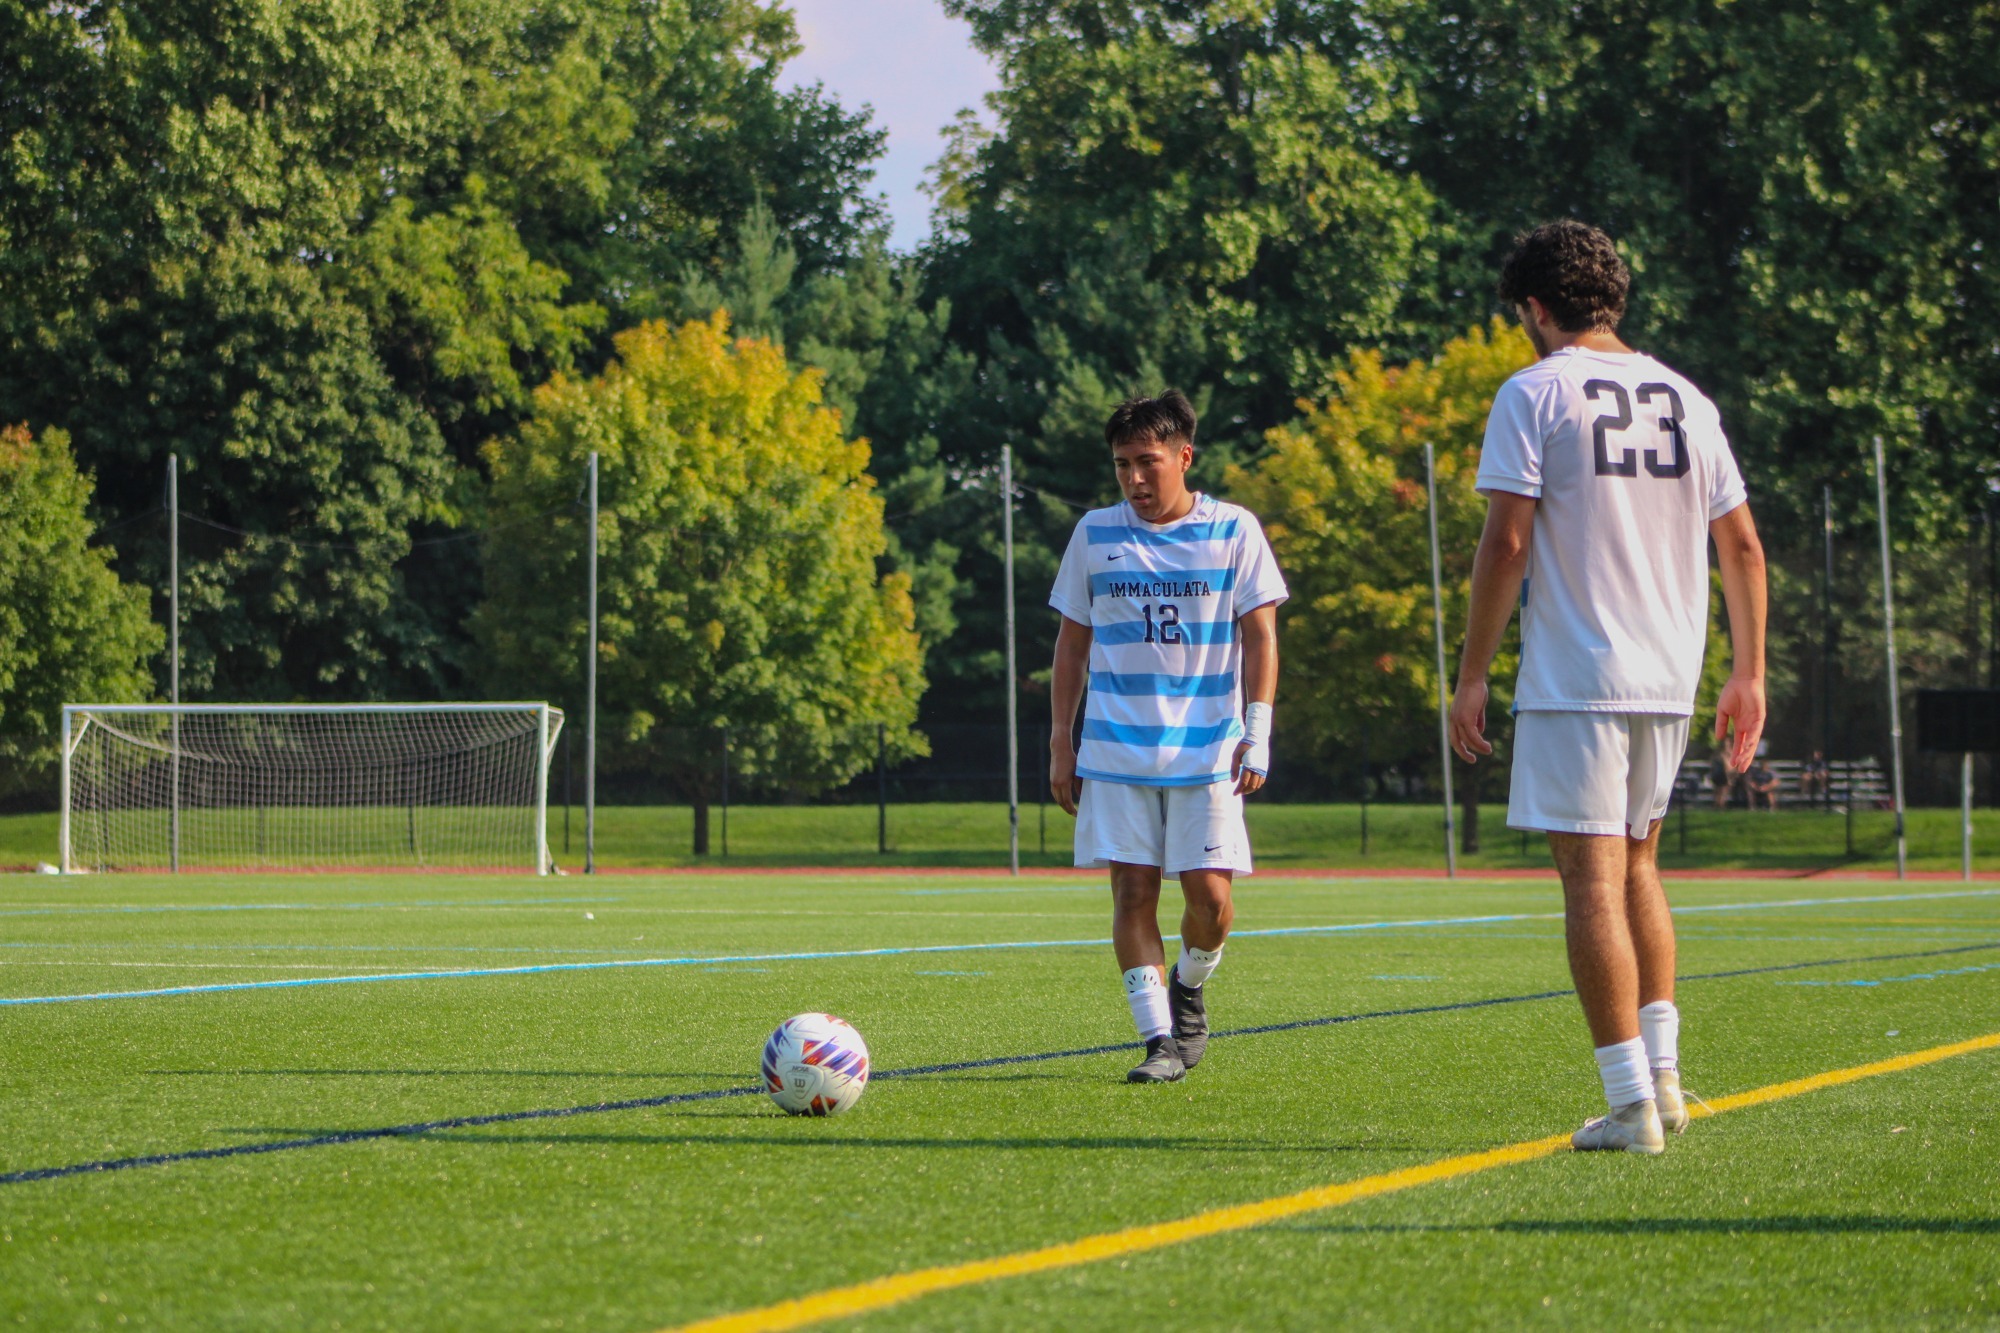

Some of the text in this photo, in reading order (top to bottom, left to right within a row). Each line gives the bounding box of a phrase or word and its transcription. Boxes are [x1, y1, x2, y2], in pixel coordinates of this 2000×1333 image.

[1583, 378, 1691, 479] 23
[1109, 581, 1211, 598] IMMACULATA
[1142, 604, 1181, 645] 12
